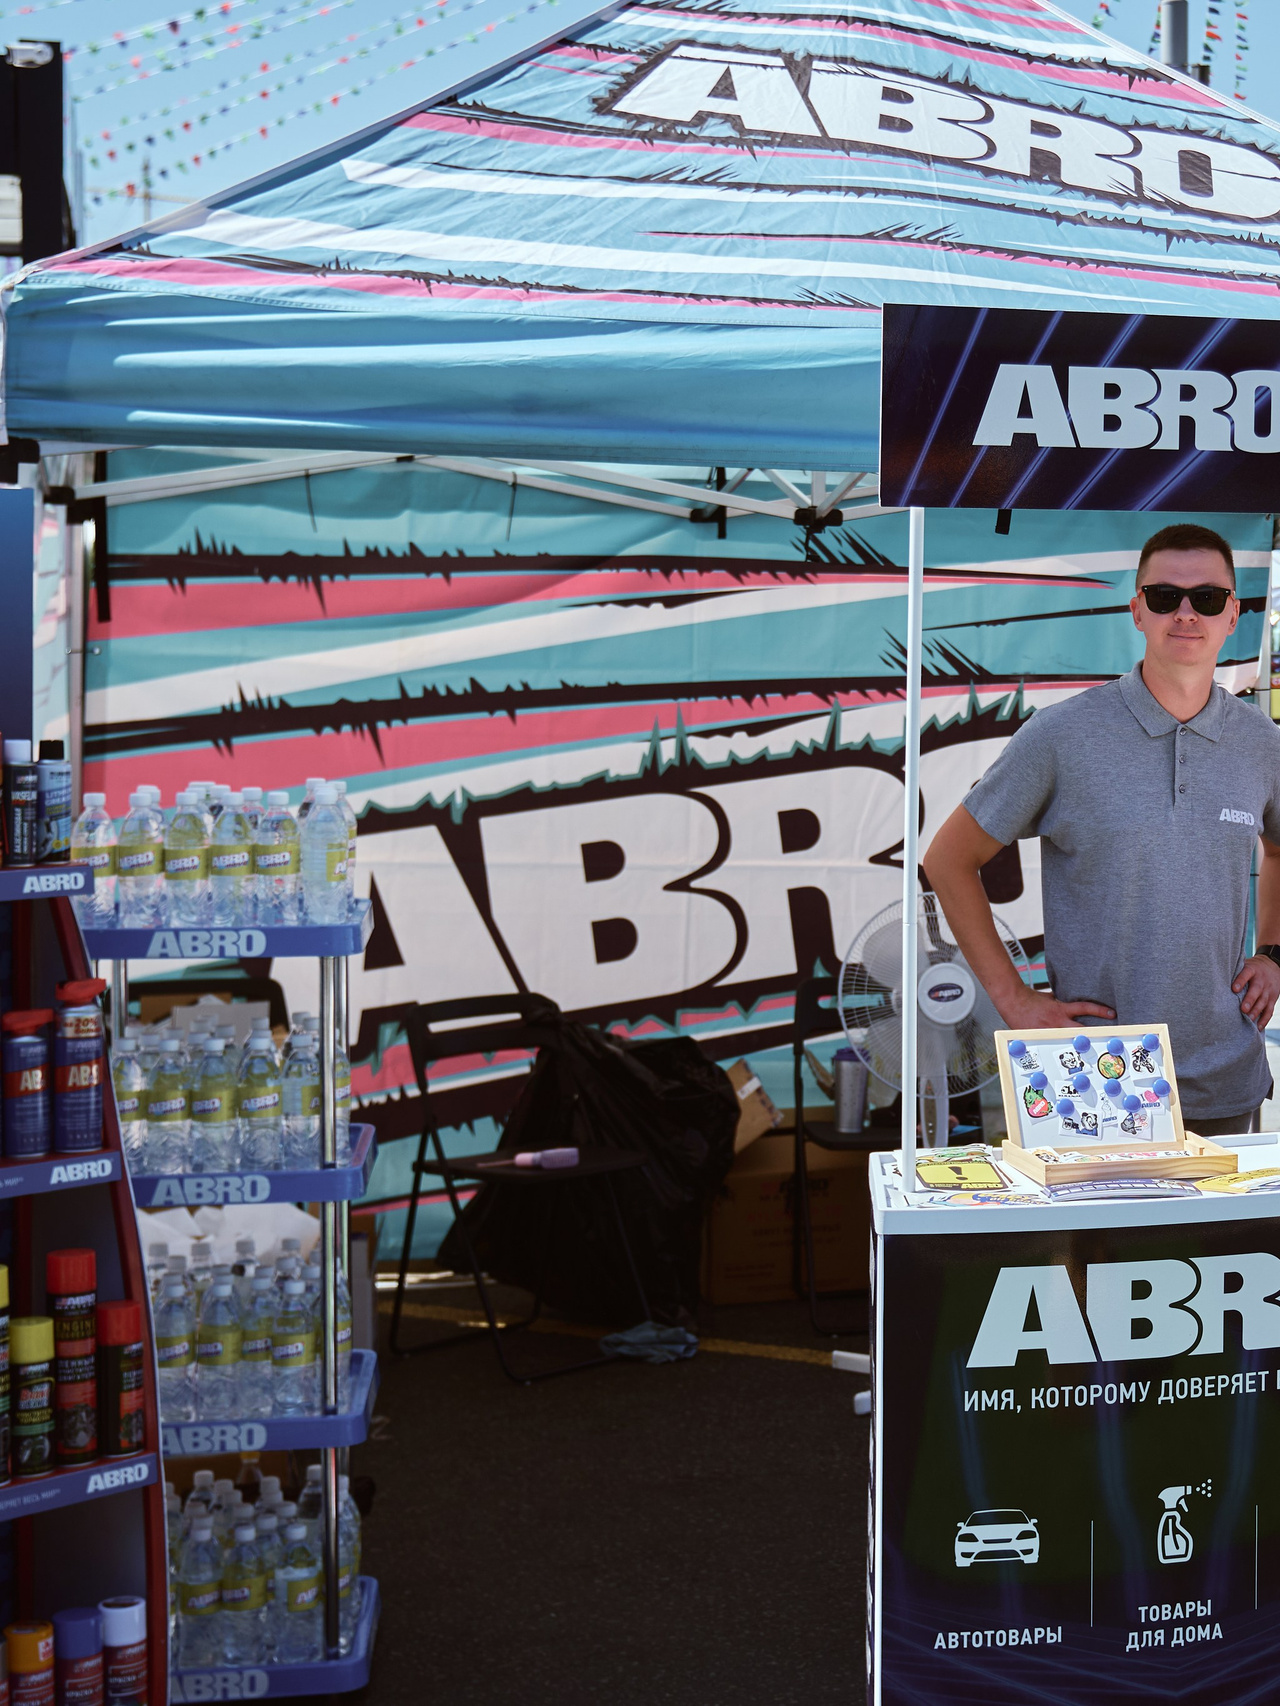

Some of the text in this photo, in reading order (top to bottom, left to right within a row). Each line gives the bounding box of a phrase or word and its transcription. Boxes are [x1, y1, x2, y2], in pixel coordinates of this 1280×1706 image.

[1220, 808, 1255, 826] ABRO
[23, 872, 85, 893] ABRO
[146, 930, 267, 958] ABRO
[50, 1158, 113, 1185] ABRO
[149, 1174, 271, 1207] ABRO
[963, 1387, 1023, 1413] ИМЯ,
[1031, 1381, 1151, 1410] КОТОРОМУ
[1157, 1370, 1270, 1404] ДОВЕРЯЕТ
[86, 1463, 149, 1494] ABRO
[1138, 1599, 1212, 1623] ТОВАРЫ
[934, 1626, 1063, 1650] АВТОТОВАРЫ
[1125, 1623, 1224, 1652] ДЛЯ ДОМА
